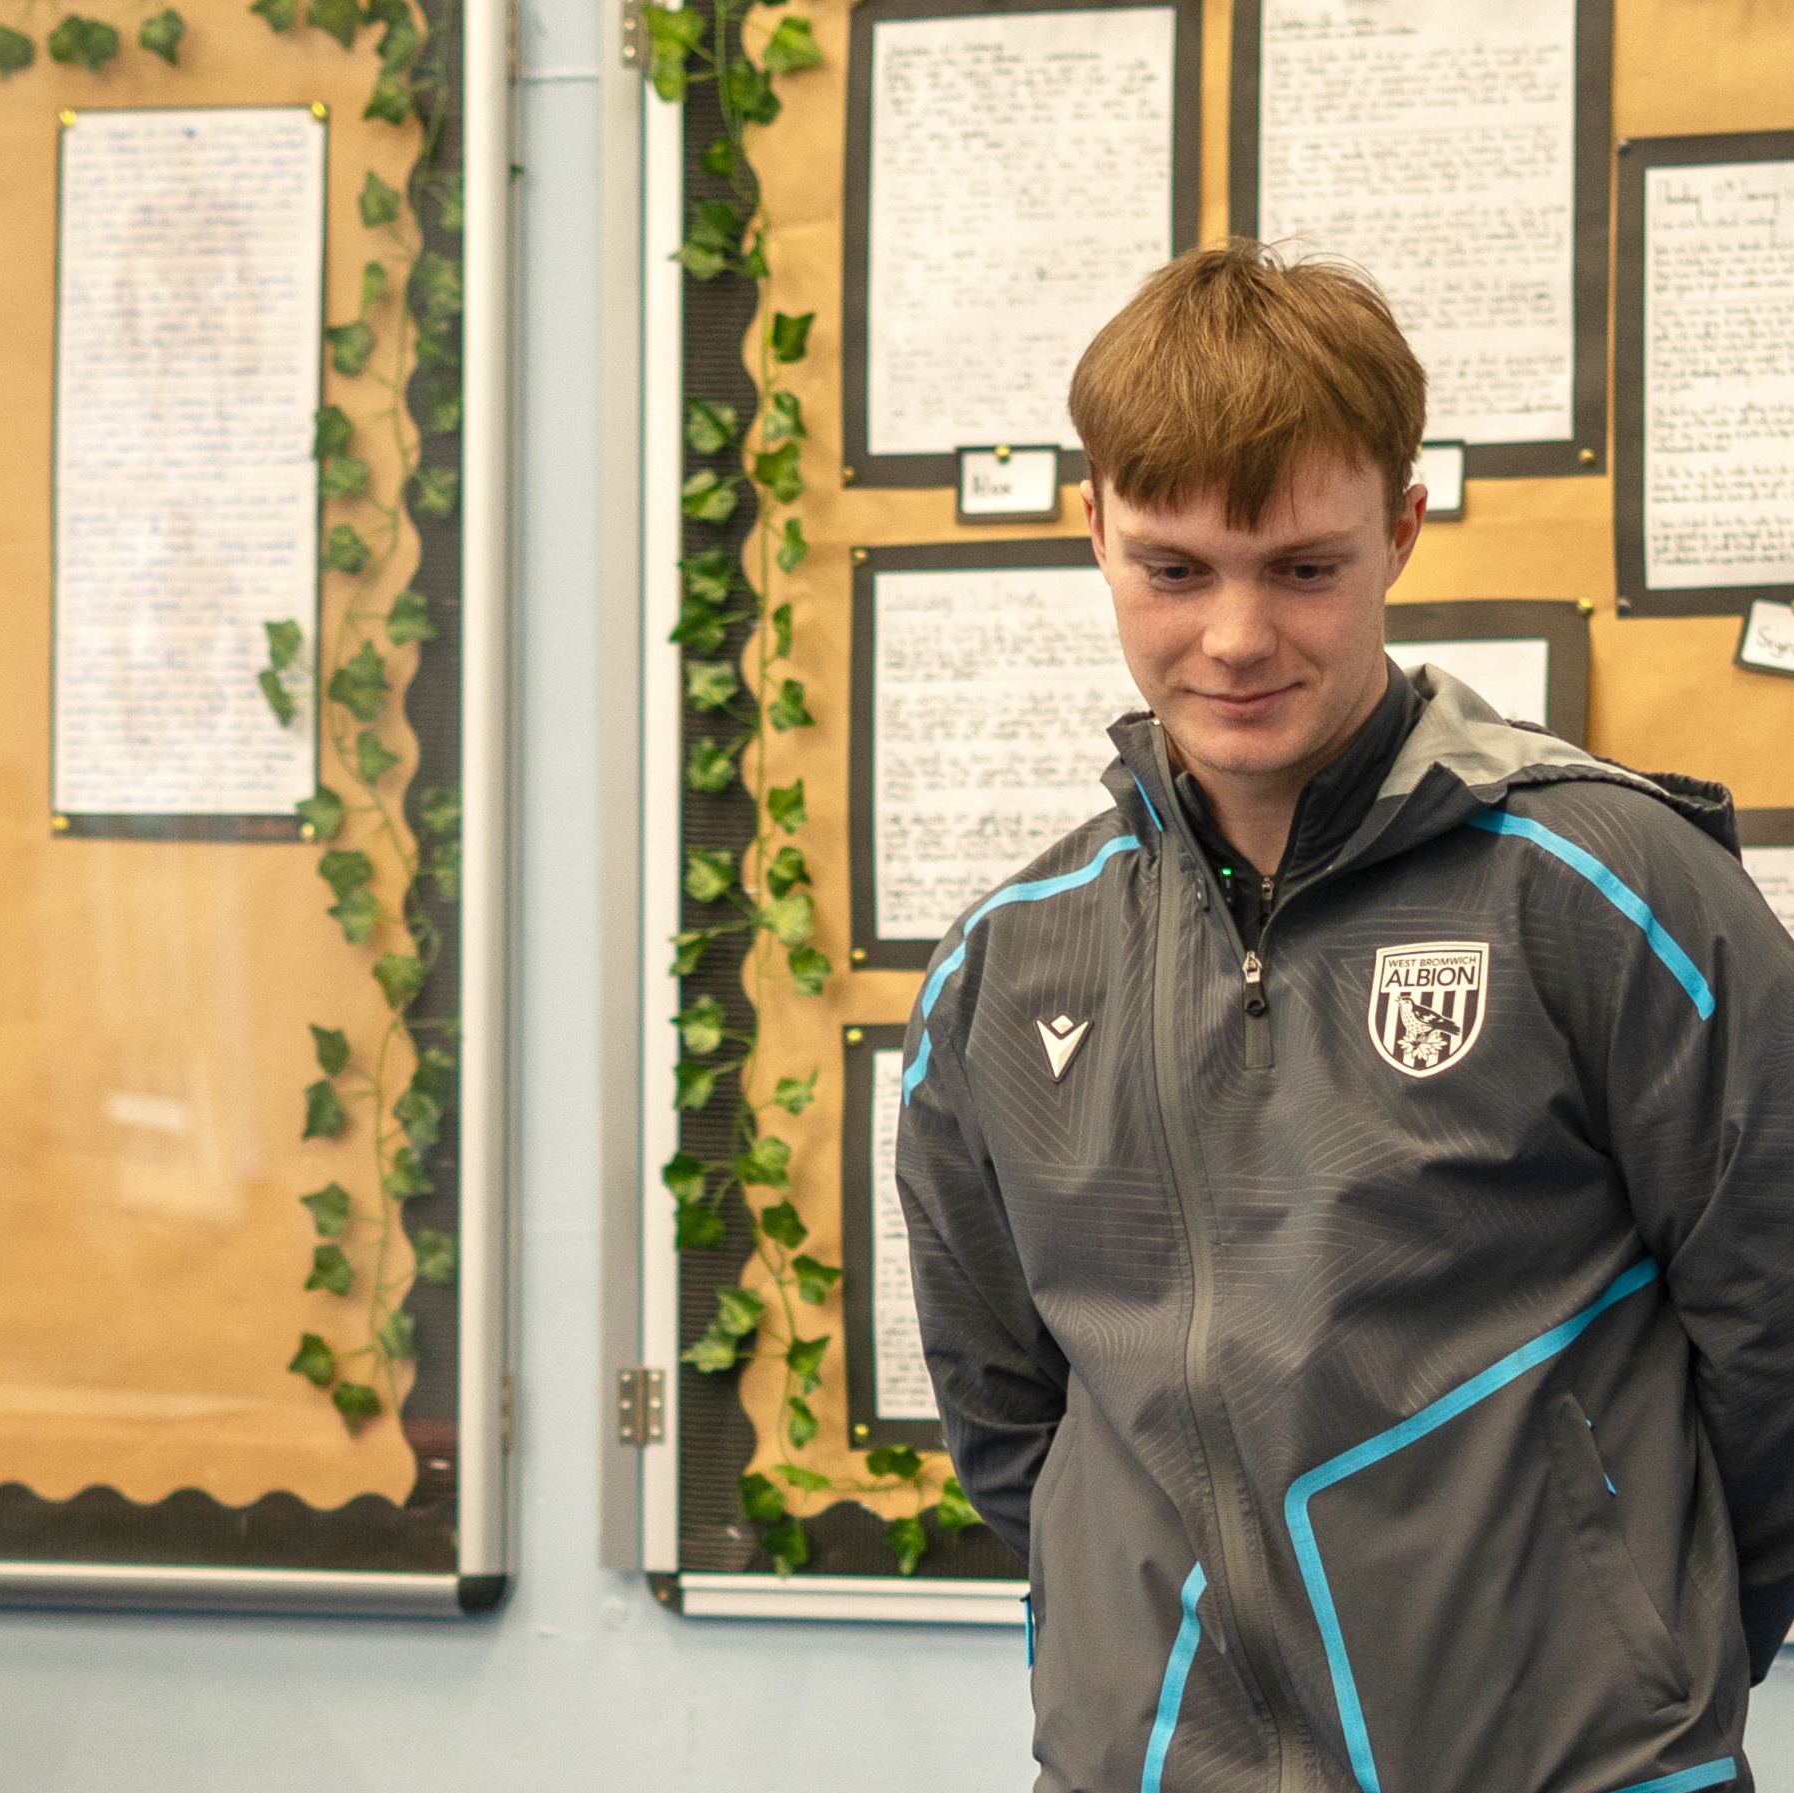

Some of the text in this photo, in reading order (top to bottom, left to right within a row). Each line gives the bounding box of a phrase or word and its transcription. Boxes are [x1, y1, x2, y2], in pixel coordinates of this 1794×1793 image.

[1388, 956, 1476, 967] WEST BROMWICH
[1385, 966, 1475, 987] ALBION
